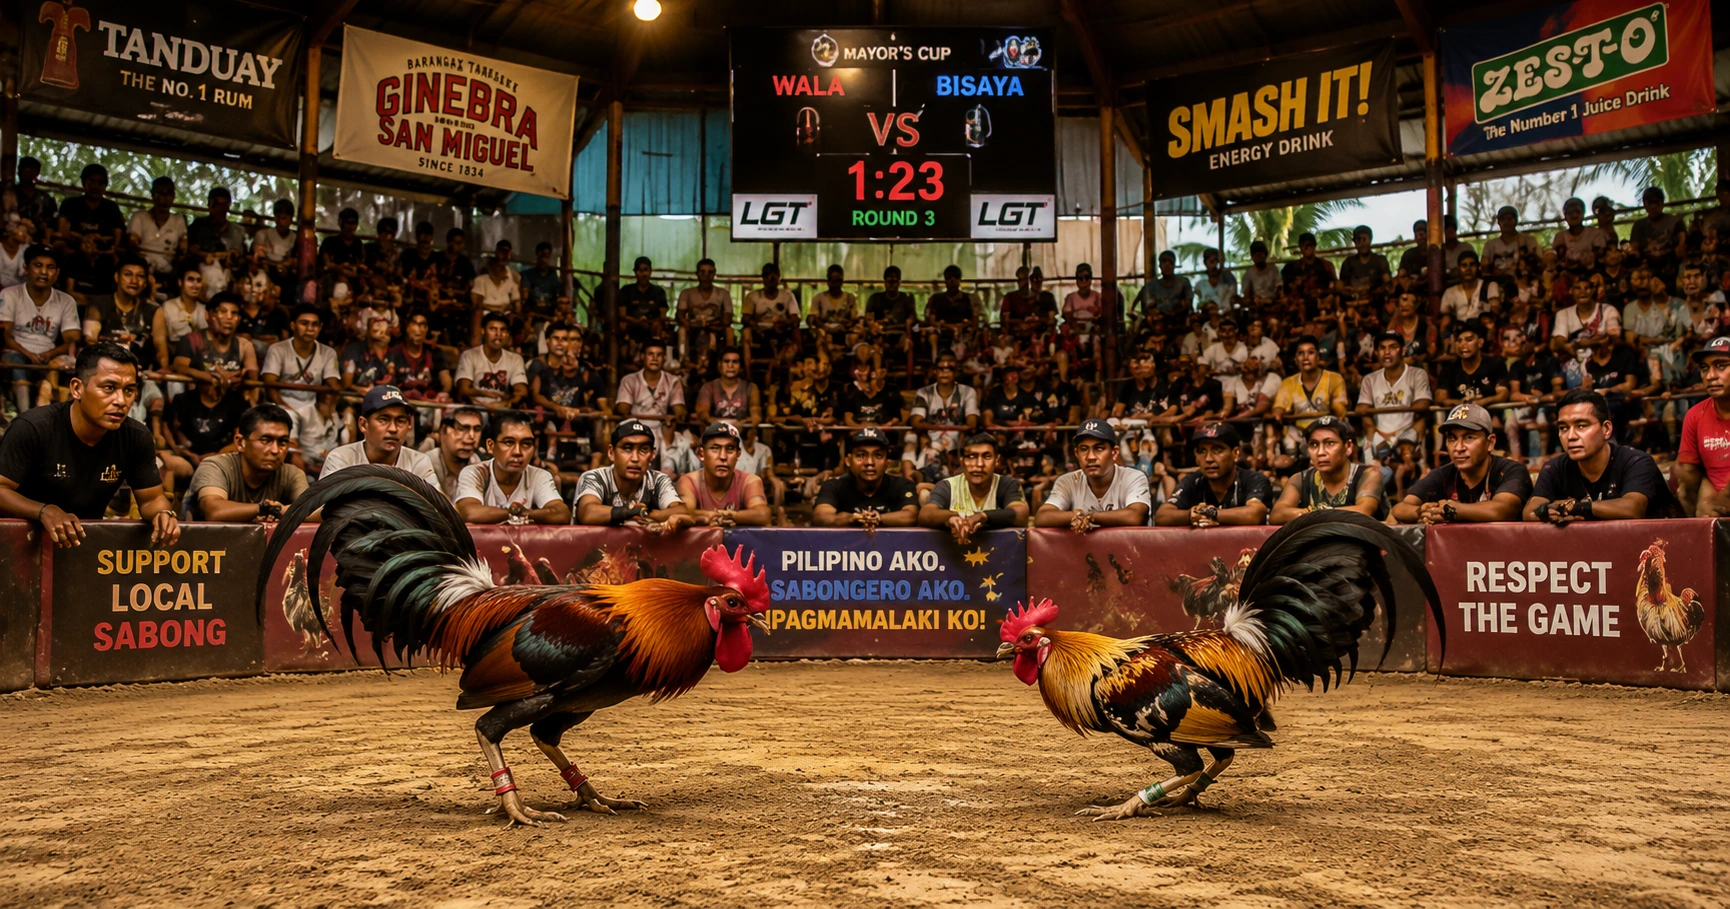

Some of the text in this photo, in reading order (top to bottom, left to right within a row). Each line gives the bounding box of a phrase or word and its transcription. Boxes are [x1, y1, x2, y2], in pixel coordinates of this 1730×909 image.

[98, 20, 282, 89] TANDUAY
[844, 46, 951, 61] MAYOR'S CUP
[1479, 17, 1656, 113] ZEST-O
[120, 70, 253, 109] THE NO. 1 RUM
[772, 75, 845, 96] WALA
[936, 75, 1025, 96] BISAYA
[376, 72, 538, 150] GINEBRA
[1168, 61, 1373, 159] SMASH IT!
[1483, 83, 1671, 140] The Number 1 Juice Drink
[377, 115, 534, 172] SAN MIGUEL
[867, 112, 920, 147] VS
[1209, 130, 1334, 170] ENERGY DRINK
[418, 157, 484, 178] SINCE 1834
[848, 160, 945, 201] 1:23
[740, 201, 808, 225] LGT
[852, 210, 935, 226] ROUND 3
[977, 202, 1048, 226] LGT
[97, 549, 227, 575] SUPPORT
[781, 550, 946, 571] PILIPINO AKO.
[771, 579, 971, 601] SABONGERO AKO.
[1466, 561, 1613, 594] RESPECT
[112, 582, 213, 612] LOCAL
[93, 618, 227, 652] SABONG
[765, 609, 986, 630] IPAGMAMALAKI KO!
[1458, 602, 1621, 638] THE GAME
